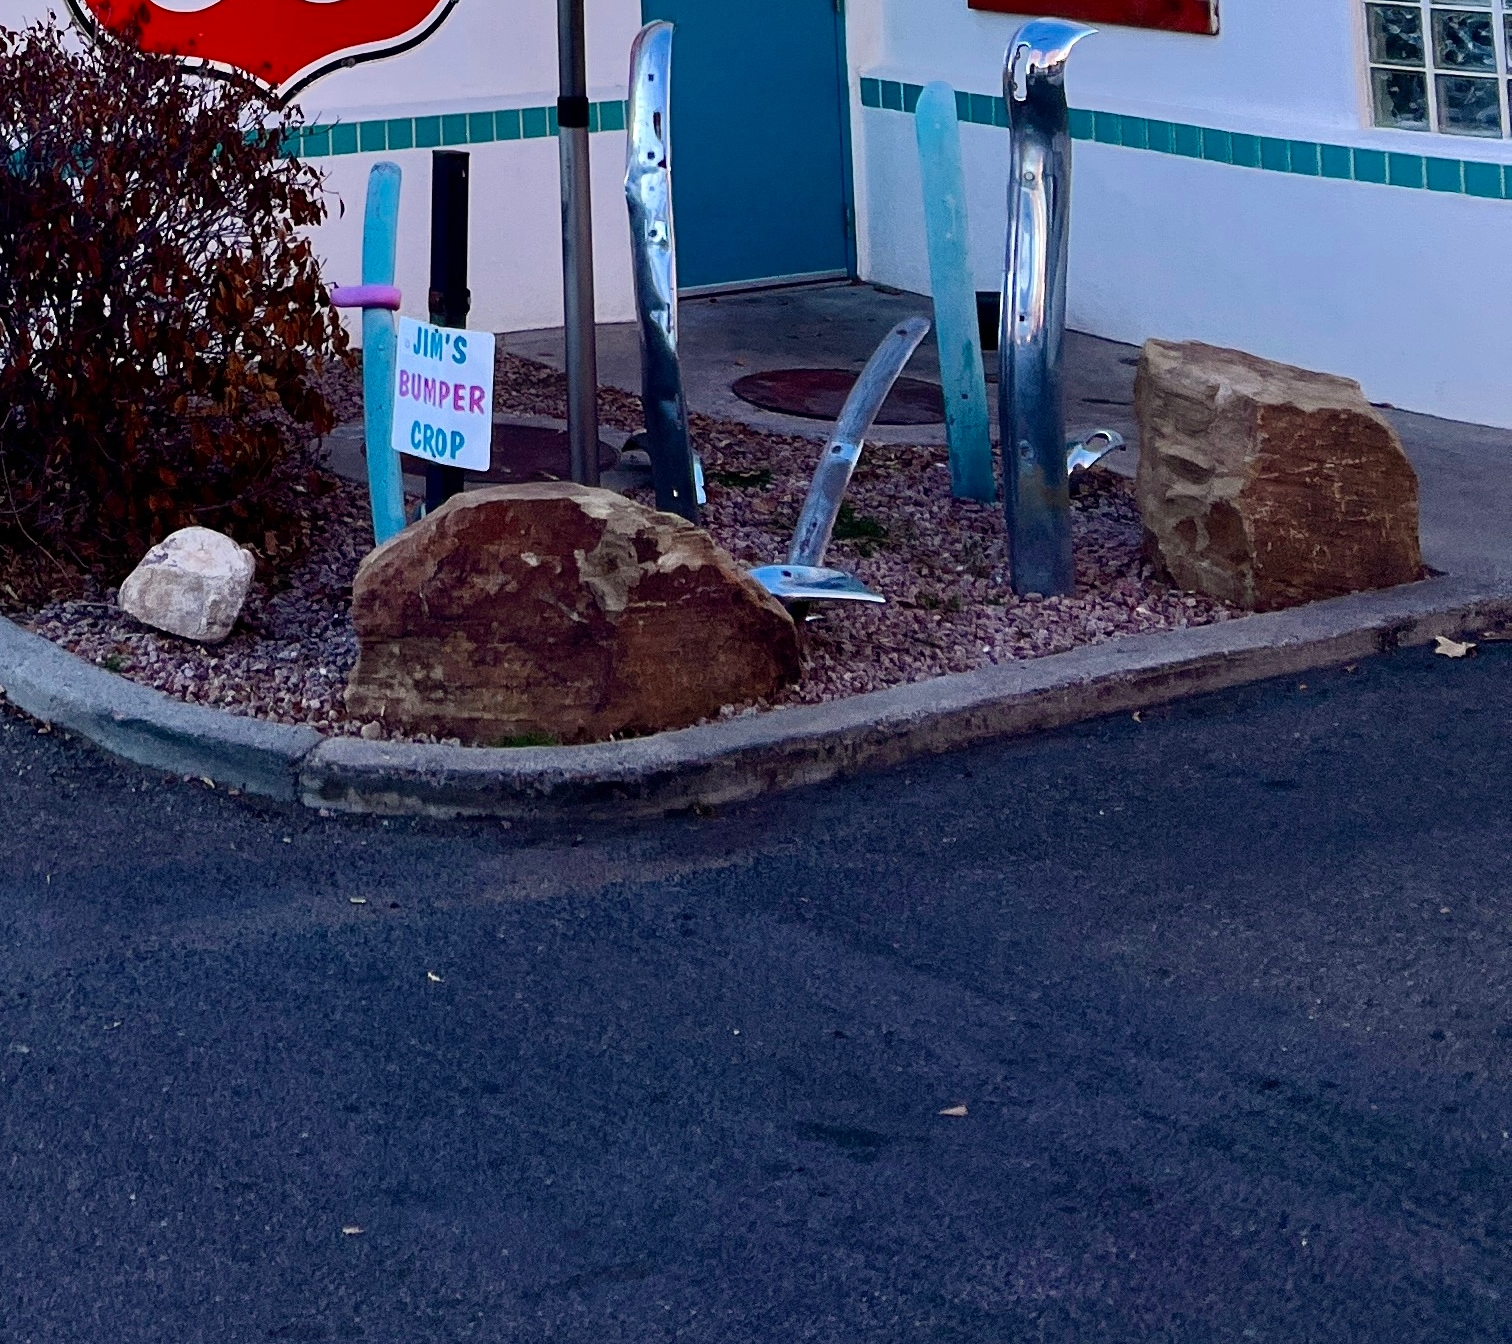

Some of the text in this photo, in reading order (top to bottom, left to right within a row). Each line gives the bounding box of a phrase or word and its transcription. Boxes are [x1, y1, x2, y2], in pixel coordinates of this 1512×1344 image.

[413, 326, 468, 365] JIM'S
[399, 369, 486, 415] BUMPER
[410, 420, 465, 460] CROP
